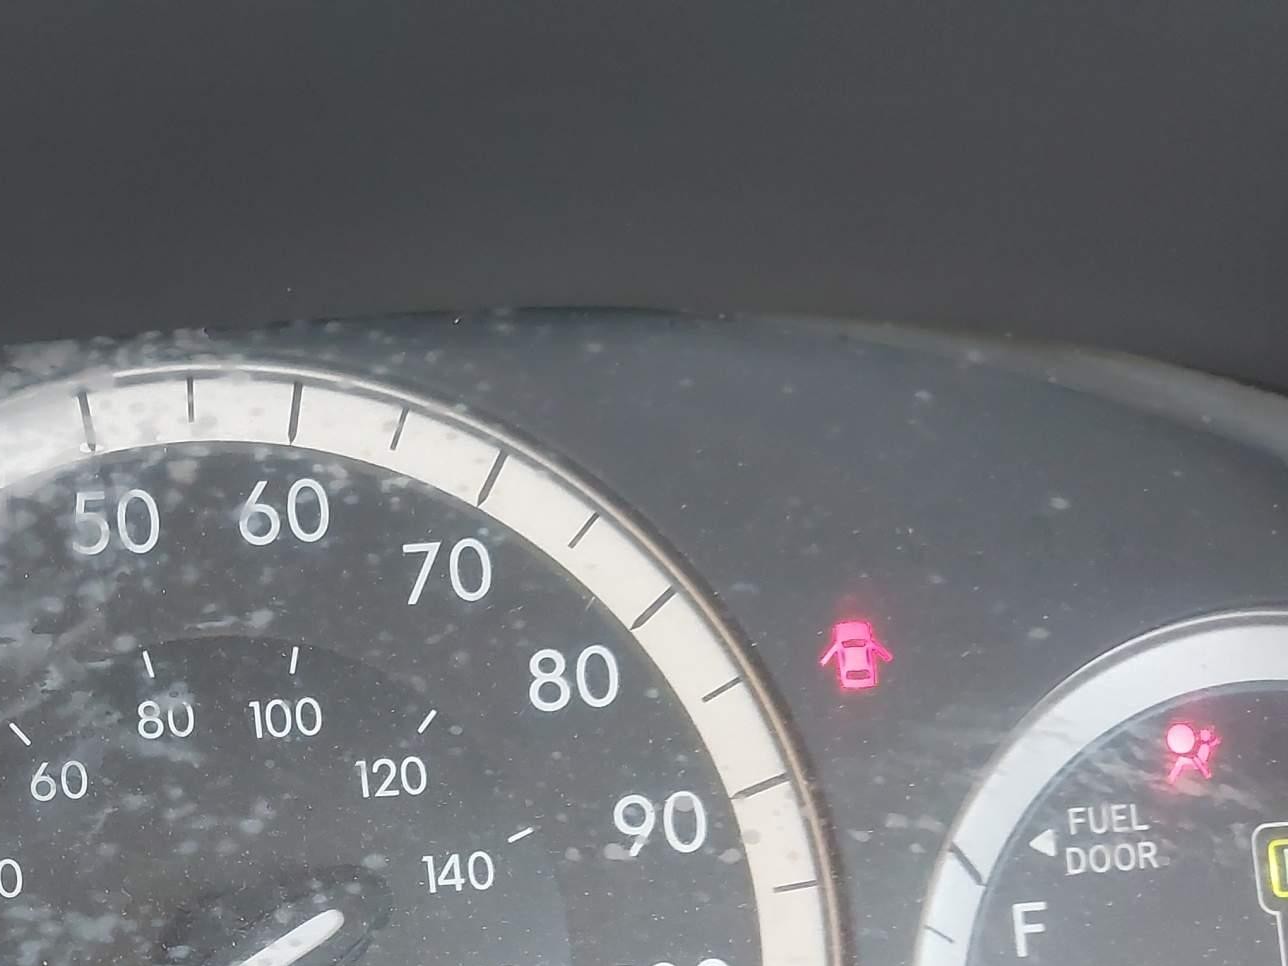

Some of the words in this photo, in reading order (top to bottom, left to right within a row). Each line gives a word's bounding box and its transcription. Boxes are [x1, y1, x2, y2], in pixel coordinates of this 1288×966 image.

[73, 489, 160, 555] 50
[239, 478, 330, 546] 60
[402, 538, 492, 605] 70
[528, 645, 619, 712] 80
[136, 700, 194, 739] 80
[248, 697, 323, 739] 100
[30, 760, 88, 802] 60
[355, 756, 428, 798] 120
[613, 791, 707, 856] 90
[1068, 803, 1149, 835] FUEL
[422, 851, 495, 893] 140
[1065, 841, 1158, 875] DOOR
[1012, 901, 1047, 958] F
